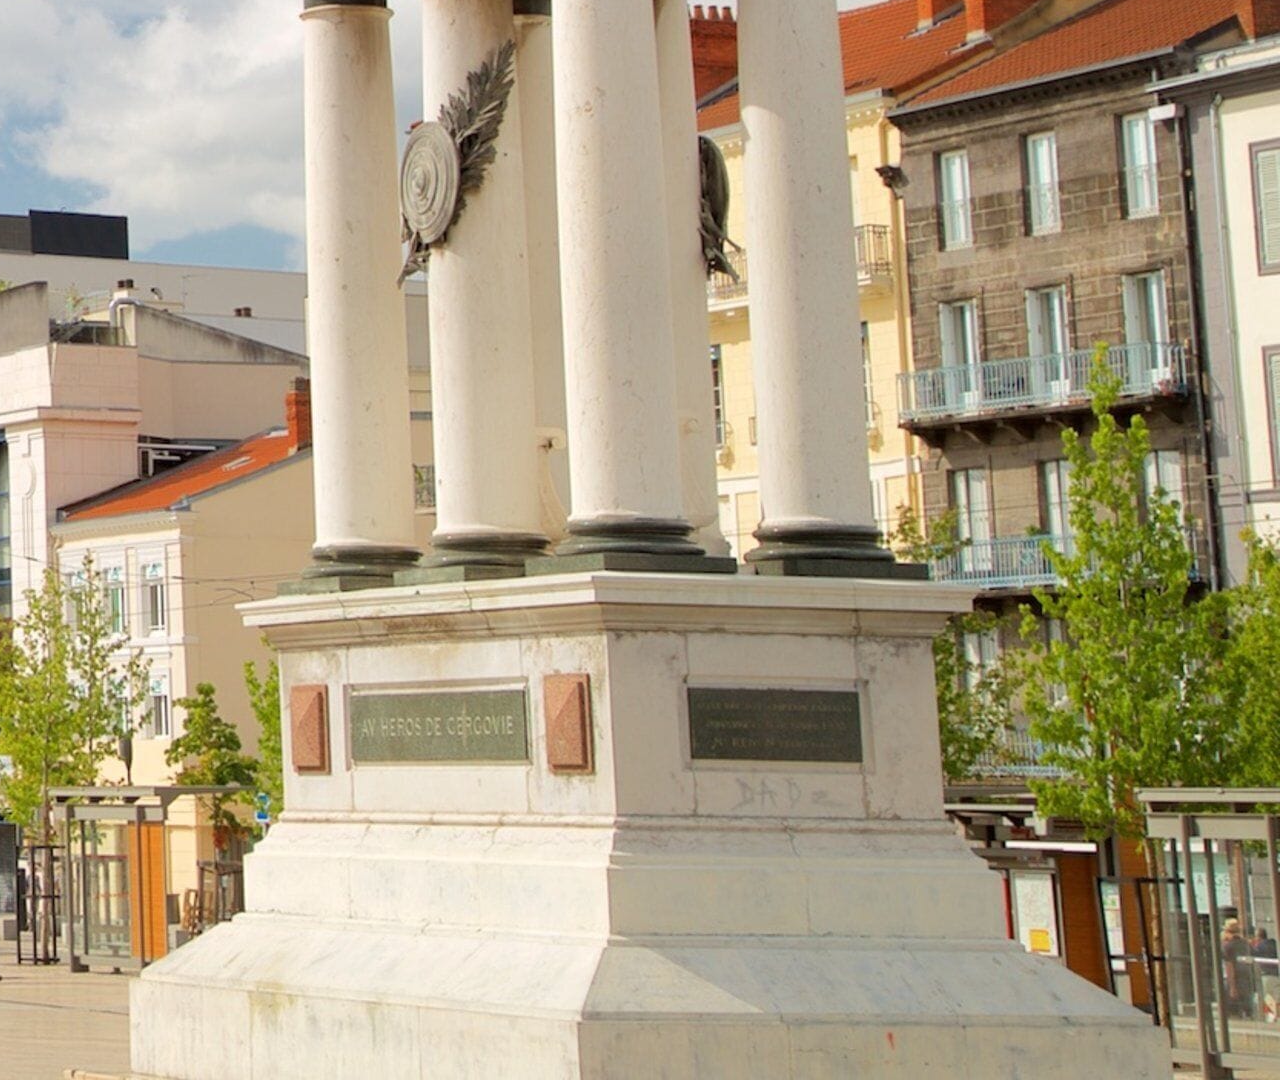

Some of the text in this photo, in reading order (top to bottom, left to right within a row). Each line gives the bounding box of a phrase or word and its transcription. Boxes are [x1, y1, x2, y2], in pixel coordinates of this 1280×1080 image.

[381, 719, 422, 736] HEROS
[426, 717, 442, 735] DE
[446, 716, 514, 735] GERGOVIE
